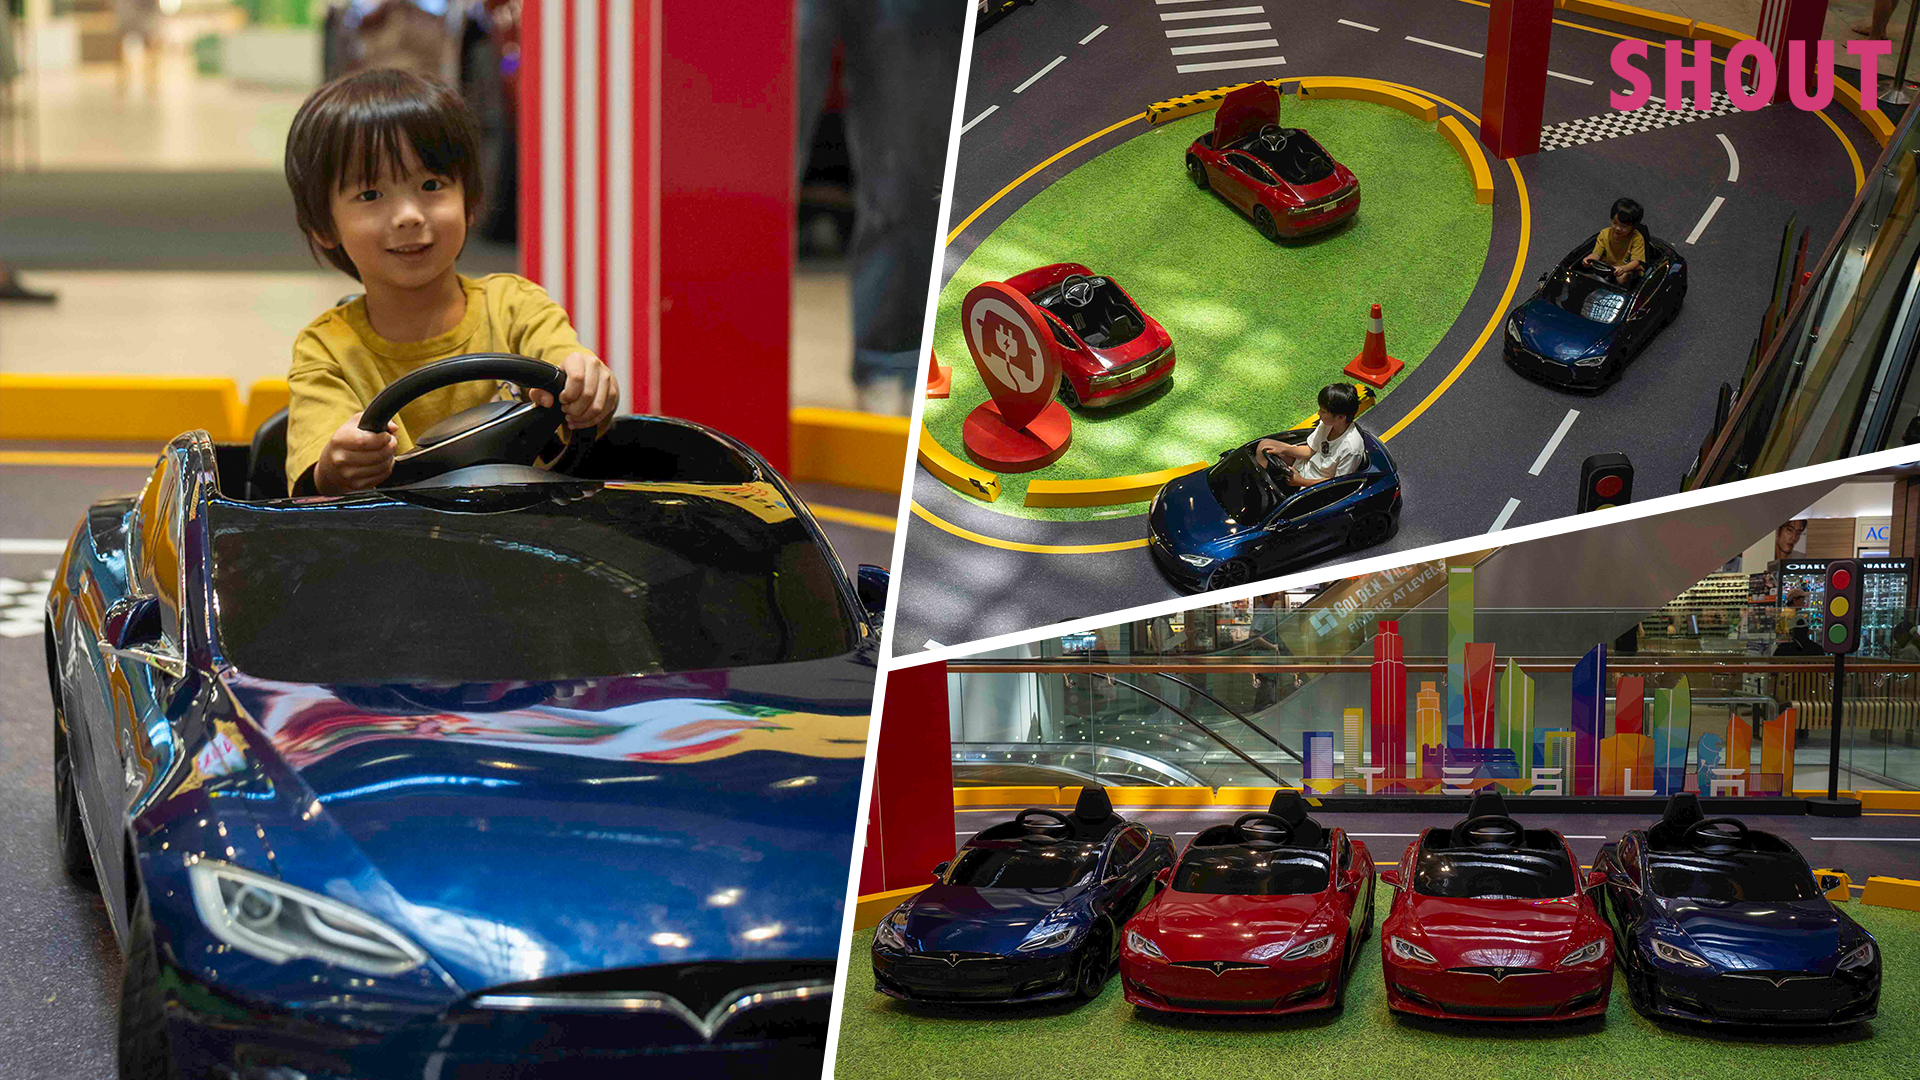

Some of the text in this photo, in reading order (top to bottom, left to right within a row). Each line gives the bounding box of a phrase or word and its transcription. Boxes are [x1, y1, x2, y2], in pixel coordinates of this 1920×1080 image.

[1333, 564, 1416, 618] GOLDEN VILL
[1348, 560, 1446, 633] FIND US AT LEVEL 5
[1353, 767, 1746, 796] TESLA
